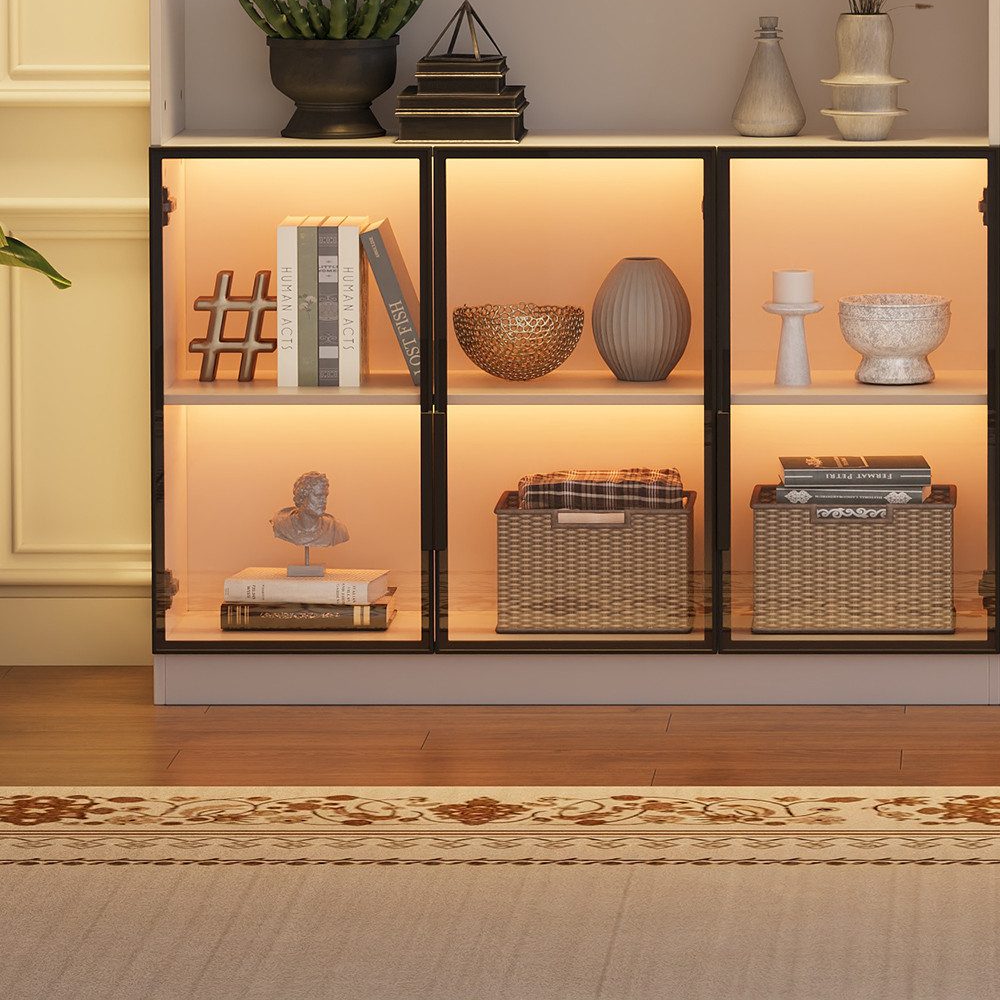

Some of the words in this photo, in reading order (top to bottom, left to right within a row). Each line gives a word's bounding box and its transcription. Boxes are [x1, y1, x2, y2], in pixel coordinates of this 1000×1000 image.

[281, 267, 293, 311] HUMAN
[343, 267, 354, 311] HUMAN
[281, 317, 293, 350] ACTS
[343, 317, 354, 350] ACTS
[389, 300, 413, 336] FISH
